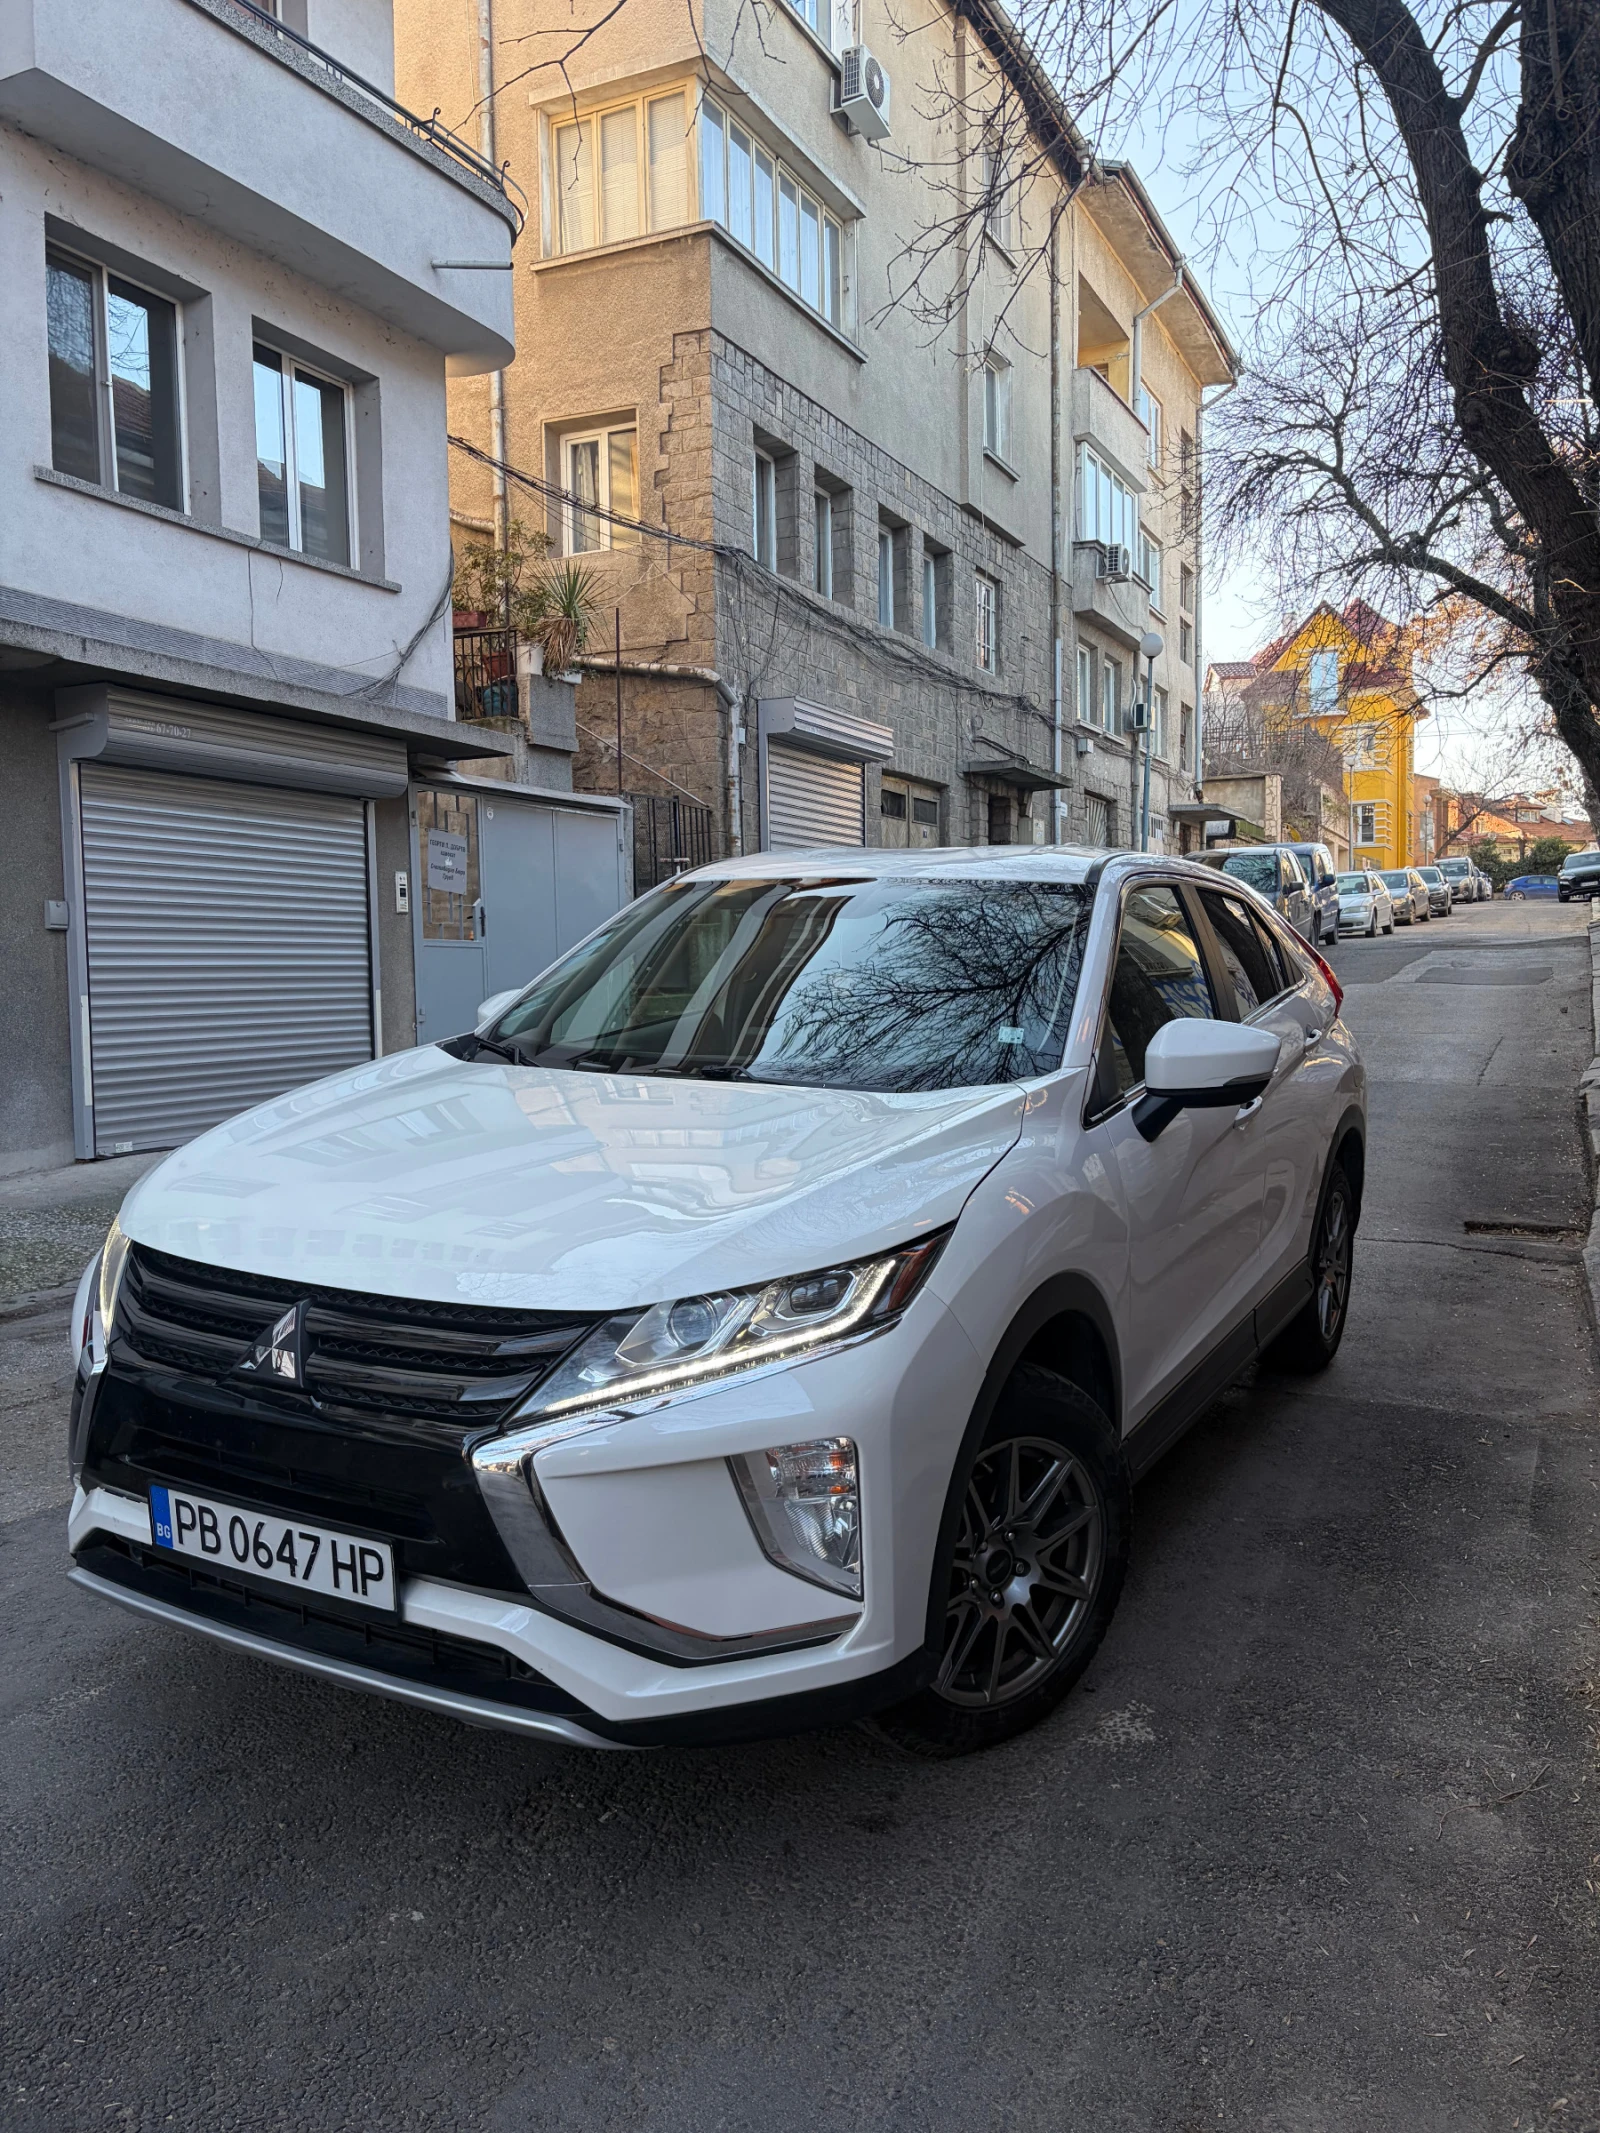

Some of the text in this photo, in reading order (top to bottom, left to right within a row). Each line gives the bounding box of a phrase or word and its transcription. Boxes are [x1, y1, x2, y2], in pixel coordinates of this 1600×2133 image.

[156, 1523, 171, 1539] BG
[174, 1498, 384, 1596] PB 0647 HP
